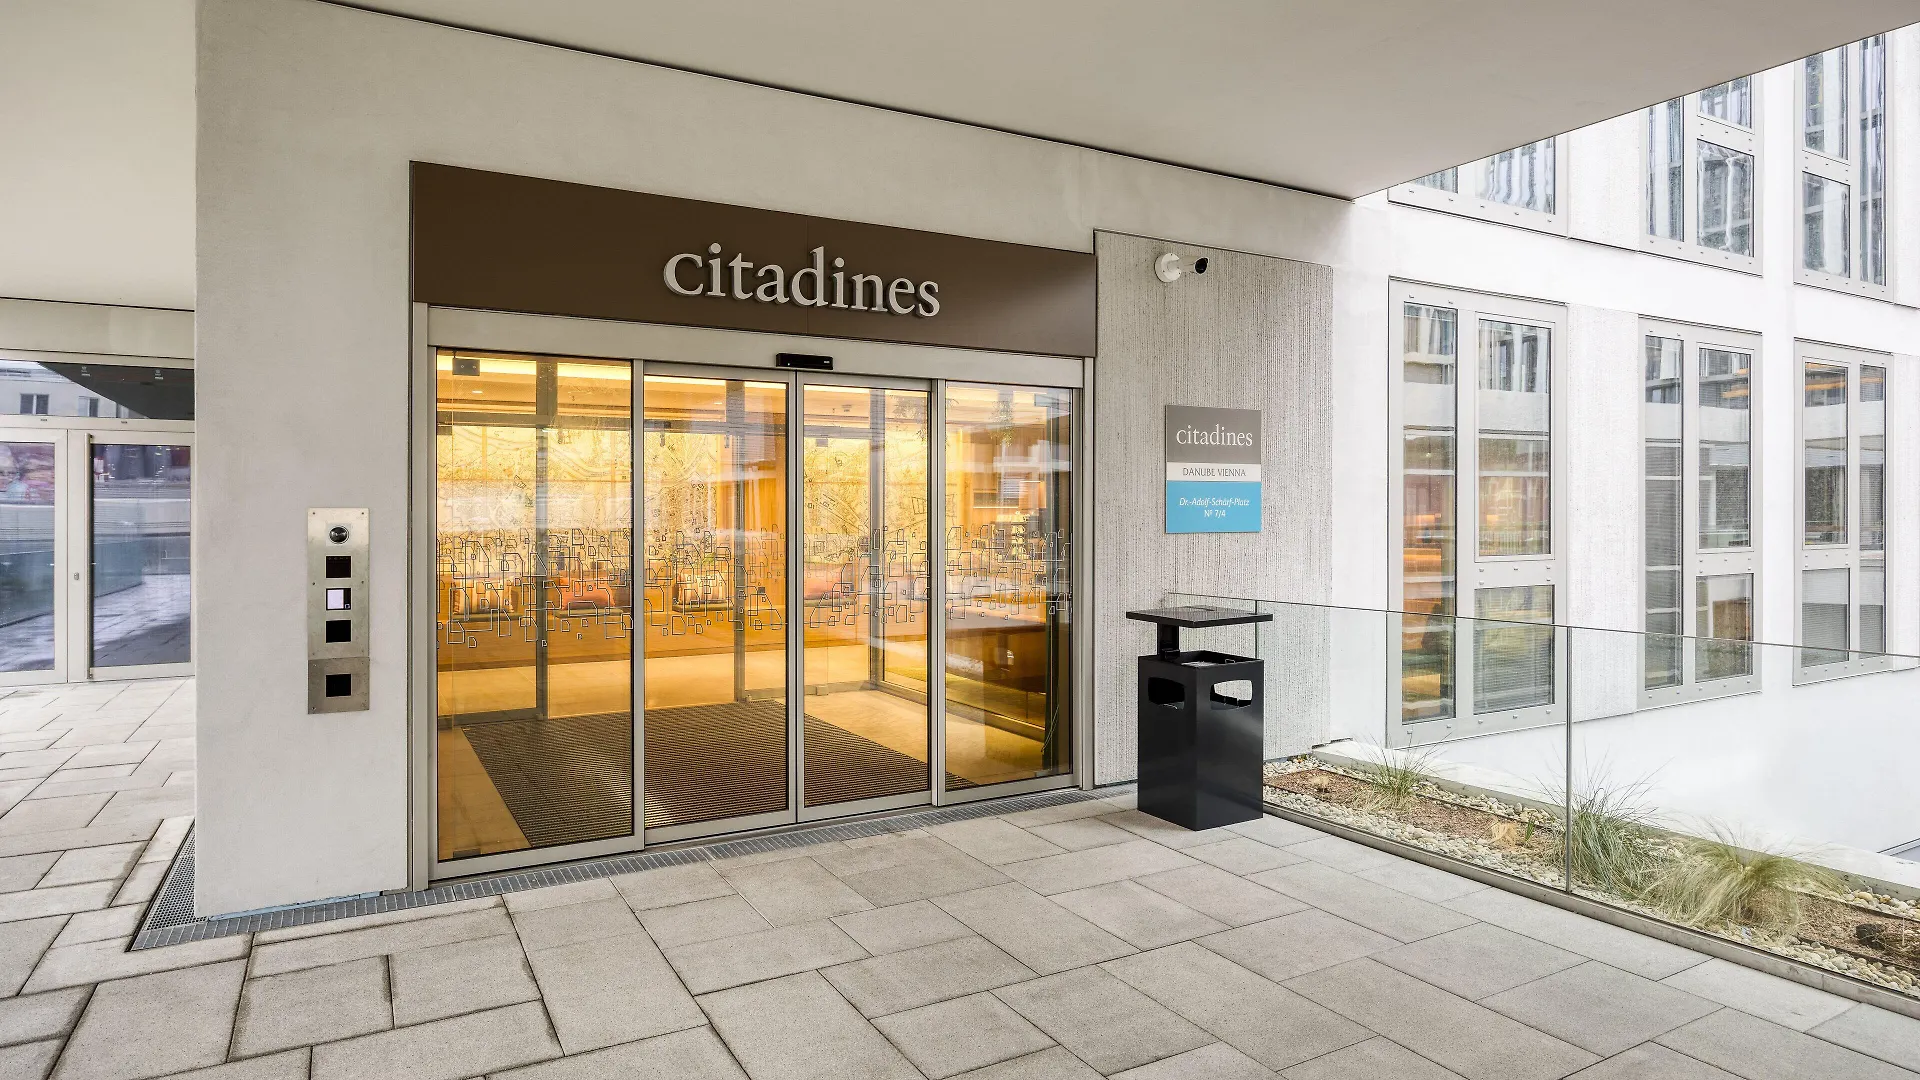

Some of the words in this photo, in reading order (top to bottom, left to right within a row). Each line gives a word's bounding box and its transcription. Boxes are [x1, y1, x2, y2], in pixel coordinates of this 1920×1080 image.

[662, 242, 941, 318] citadines
[1176, 424, 1253, 447] citadines
[1182, 467, 1216, 477] DANUBE
[1217, 468, 1247, 477] VIENNA
[1214, 509, 1226, 518] 7/4
